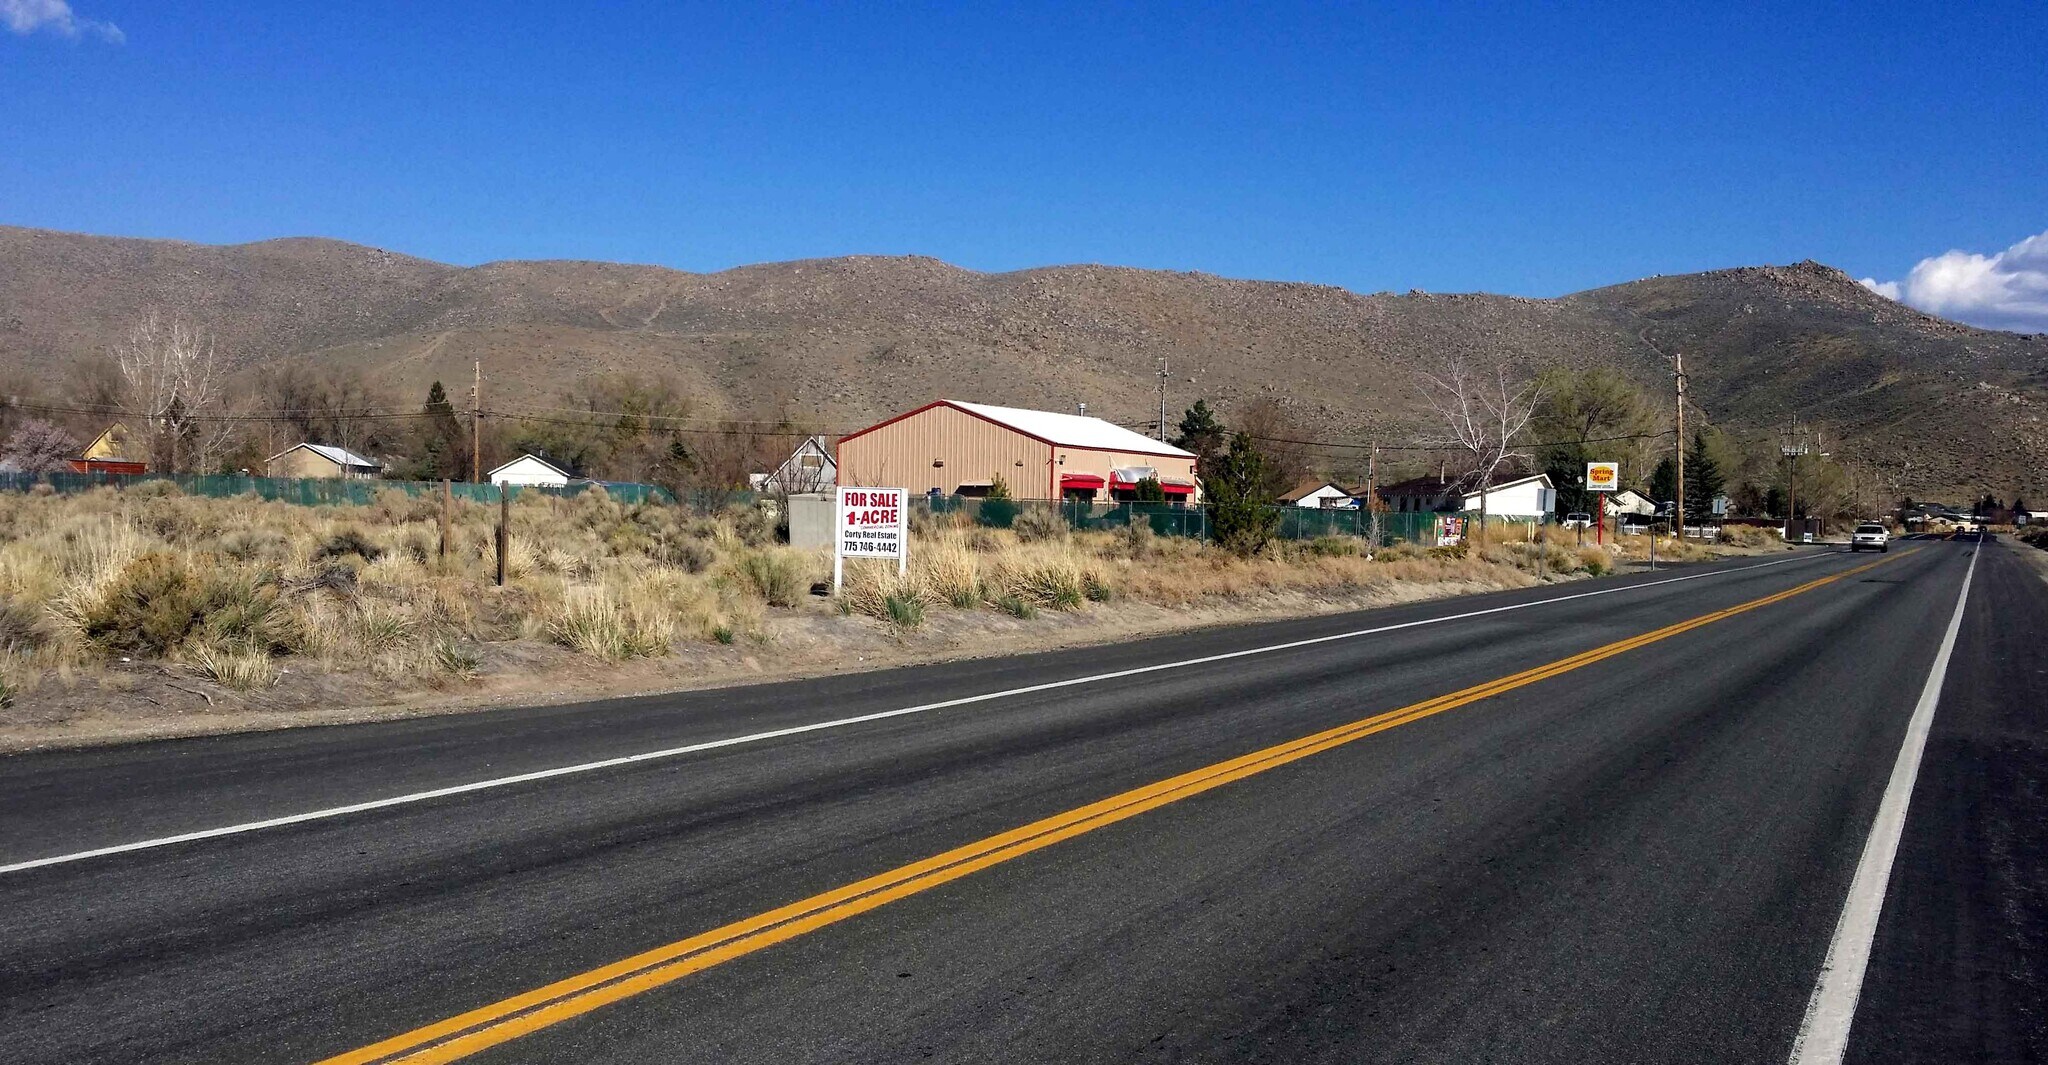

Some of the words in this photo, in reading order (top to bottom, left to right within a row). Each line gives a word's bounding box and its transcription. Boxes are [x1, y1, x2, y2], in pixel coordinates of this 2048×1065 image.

[845, 492, 866, 506] FOR
[870, 493, 898, 508] SALE
[846, 510, 898, 525] 1-ACRE
[845, 530, 862, 539] Corty
[844, 541, 858, 552] 775
[860, 542, 896, 553] 746-4442
